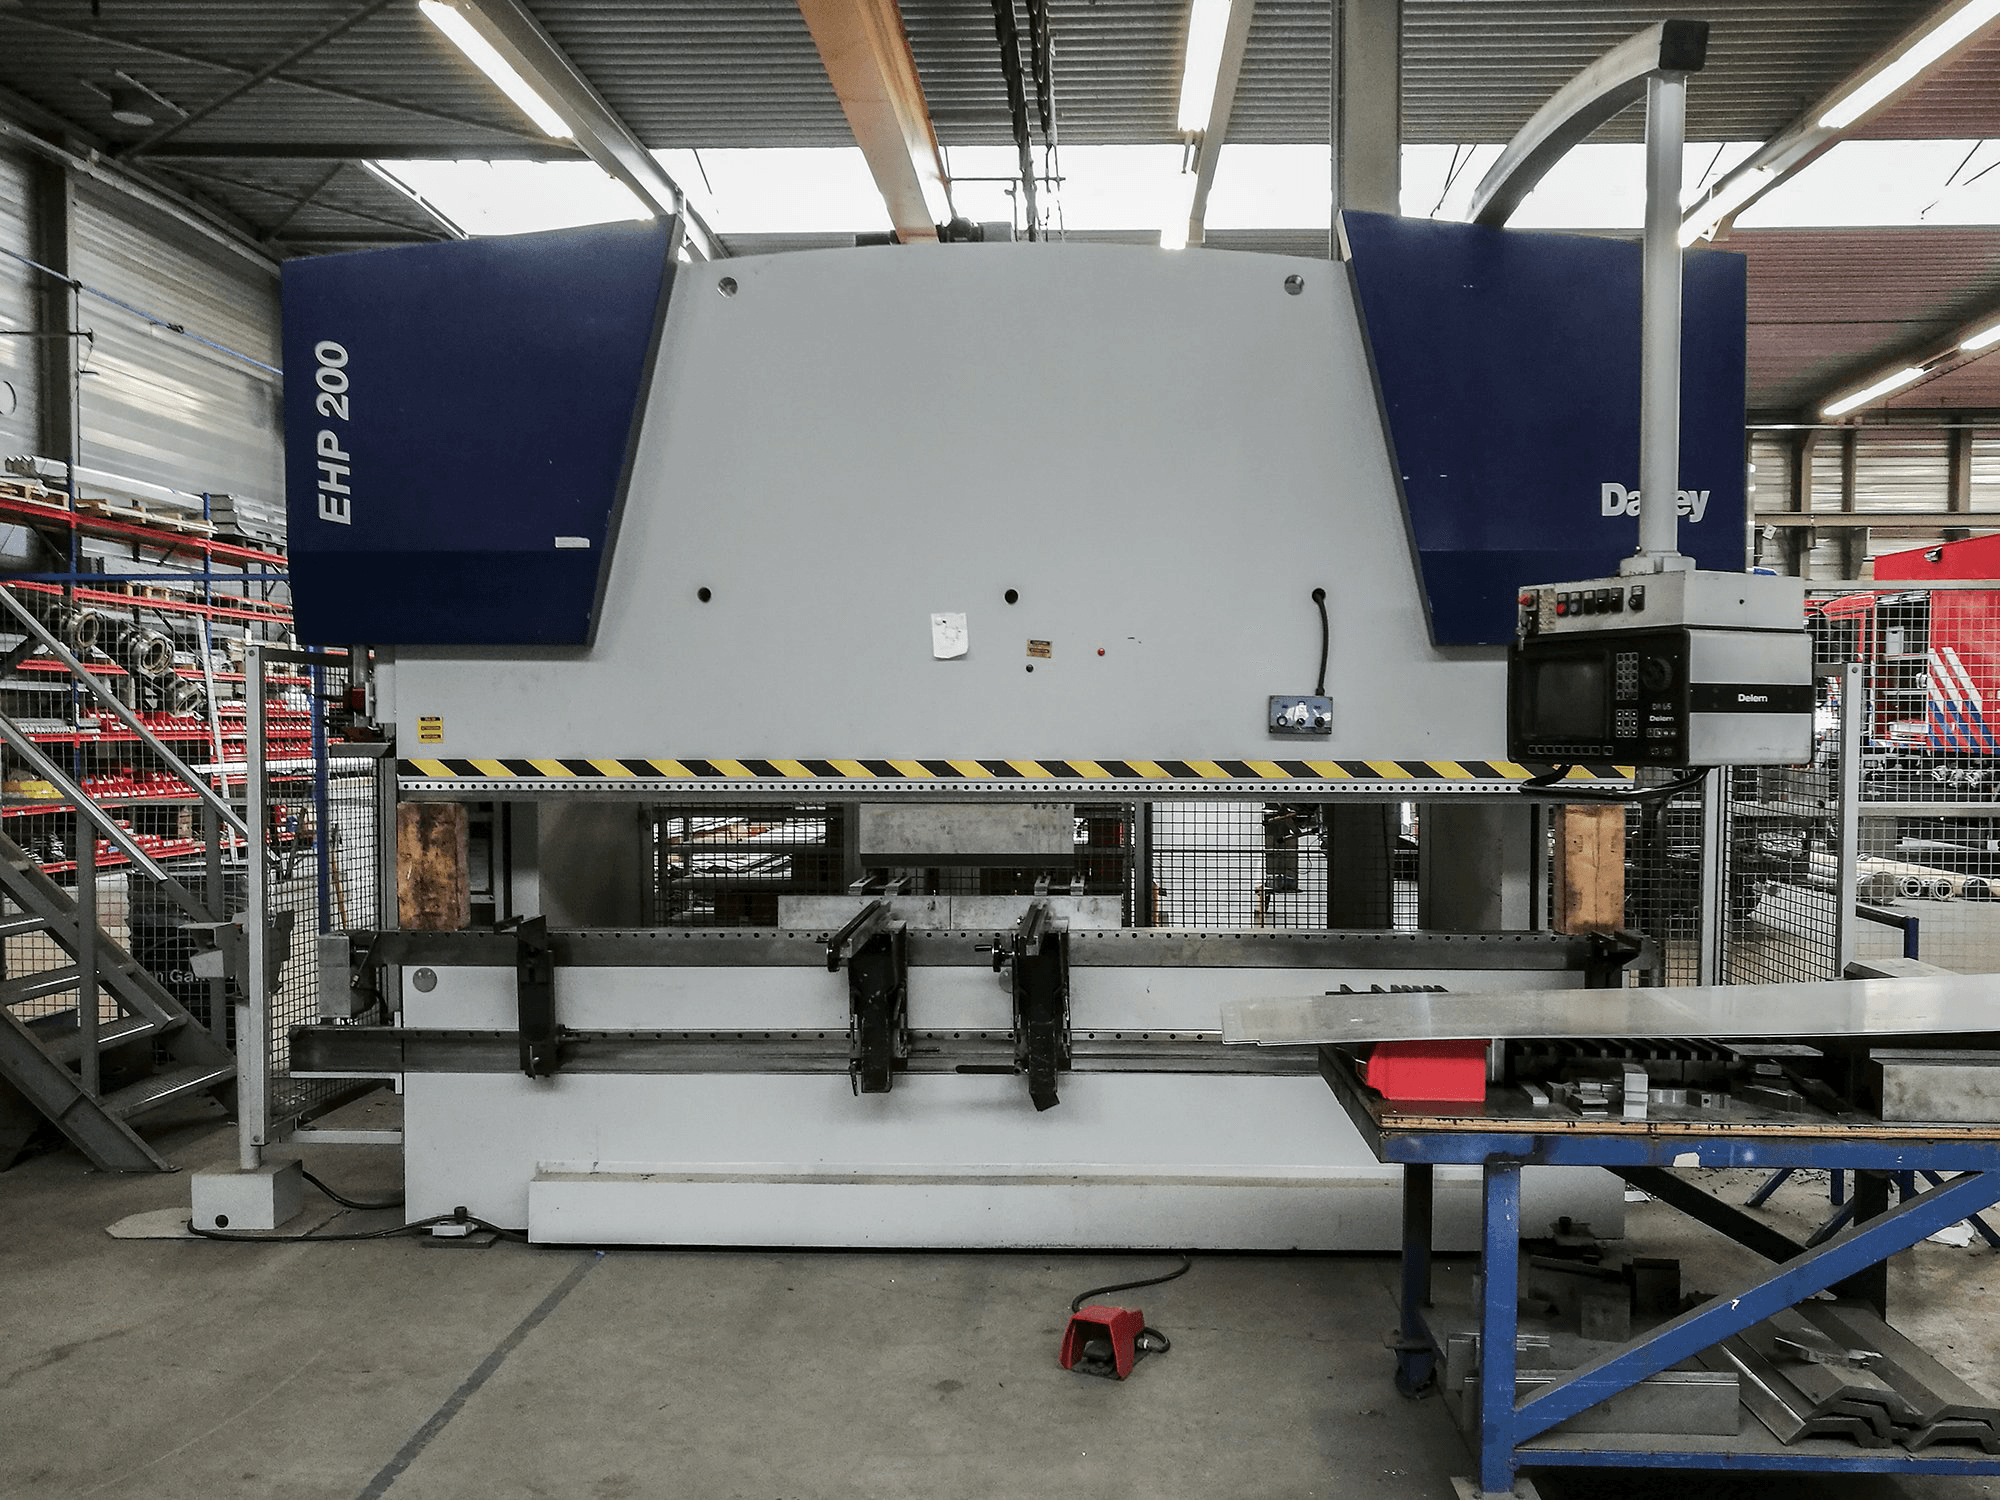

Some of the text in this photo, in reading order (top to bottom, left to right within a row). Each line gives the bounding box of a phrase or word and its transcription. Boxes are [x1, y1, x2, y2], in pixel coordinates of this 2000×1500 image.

[314, 340, 352, 525] EHP 200
[1601, 482, 1711, 523] Daey
[1737, 693, 1769, 703] Delem
